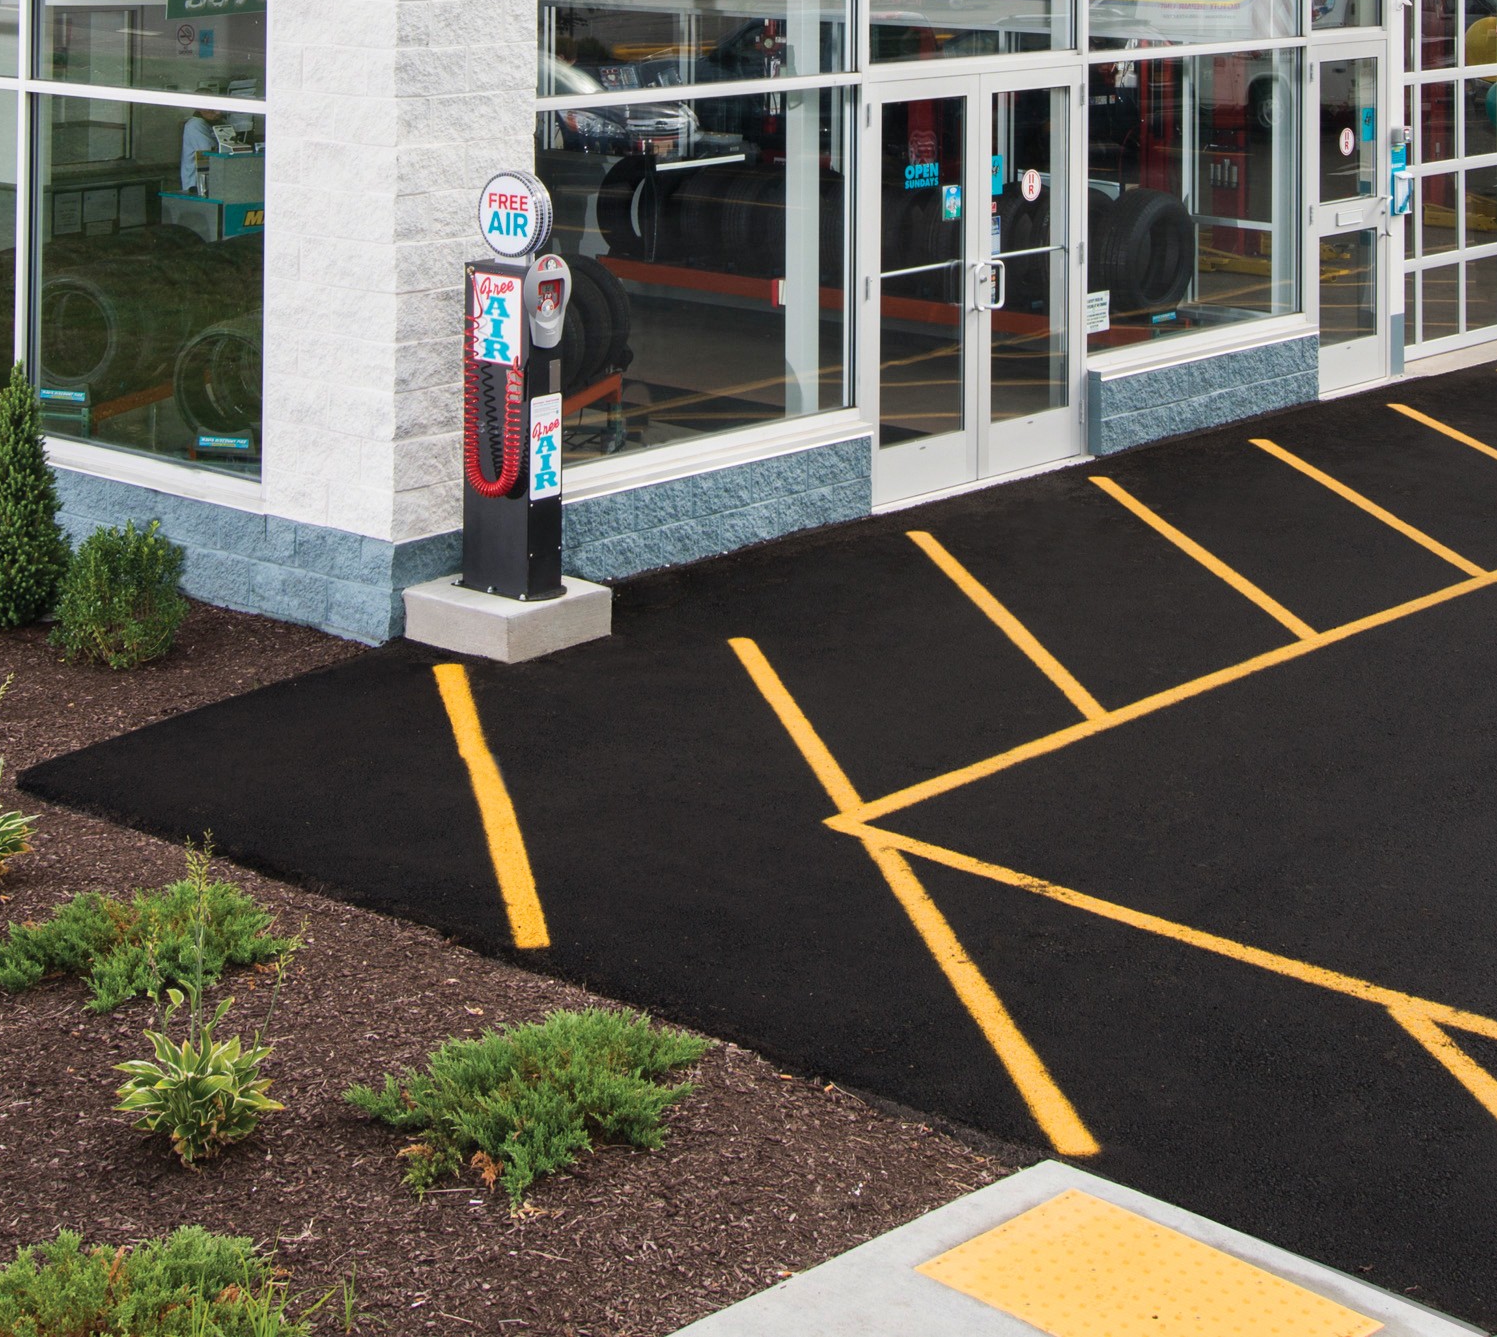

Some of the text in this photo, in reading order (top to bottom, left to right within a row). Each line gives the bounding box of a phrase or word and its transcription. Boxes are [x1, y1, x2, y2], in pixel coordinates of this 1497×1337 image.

[904, 162, 939, 180] OPEN
[904, 177, 939, 190] SUNDAYS
[1028, 184, 1035, 195] R
[488, 193, 529, 212] FREE
[487, 211, 529, 238] AIR
[479, 276, 515, 301] Free
[482, 295, 512, 363] AIR
[531, 420, 561, 442] Free
[534, 434, 558, 491] AIR
